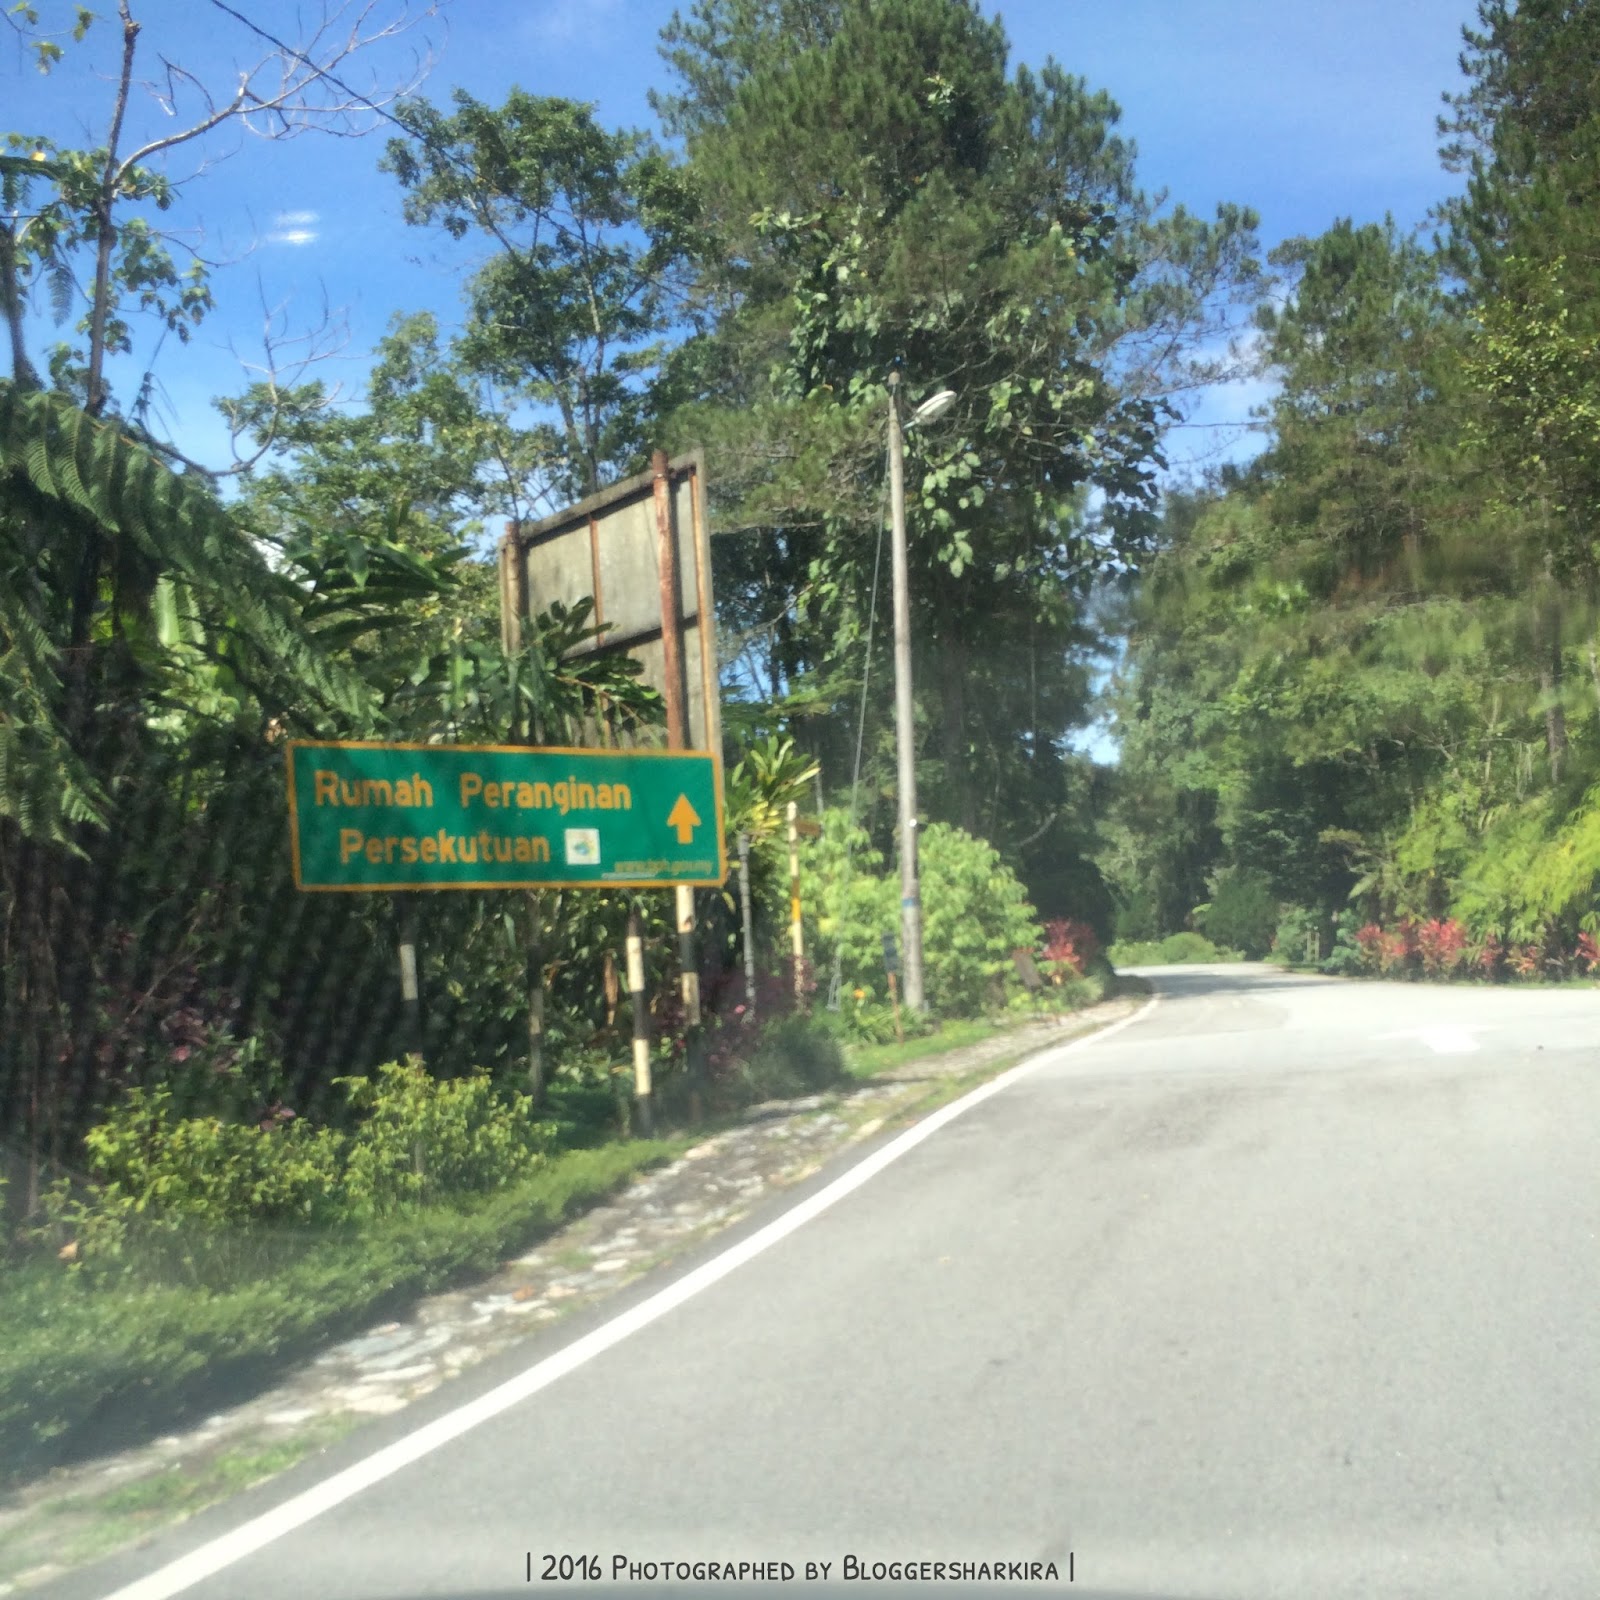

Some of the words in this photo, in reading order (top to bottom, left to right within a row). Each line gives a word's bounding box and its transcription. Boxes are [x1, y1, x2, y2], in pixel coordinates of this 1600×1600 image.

[314, 770, 433, 808] Rumah
[459, 772, 632, 815] Peranginan
[340, 828, 551, 864] Persekutuan
